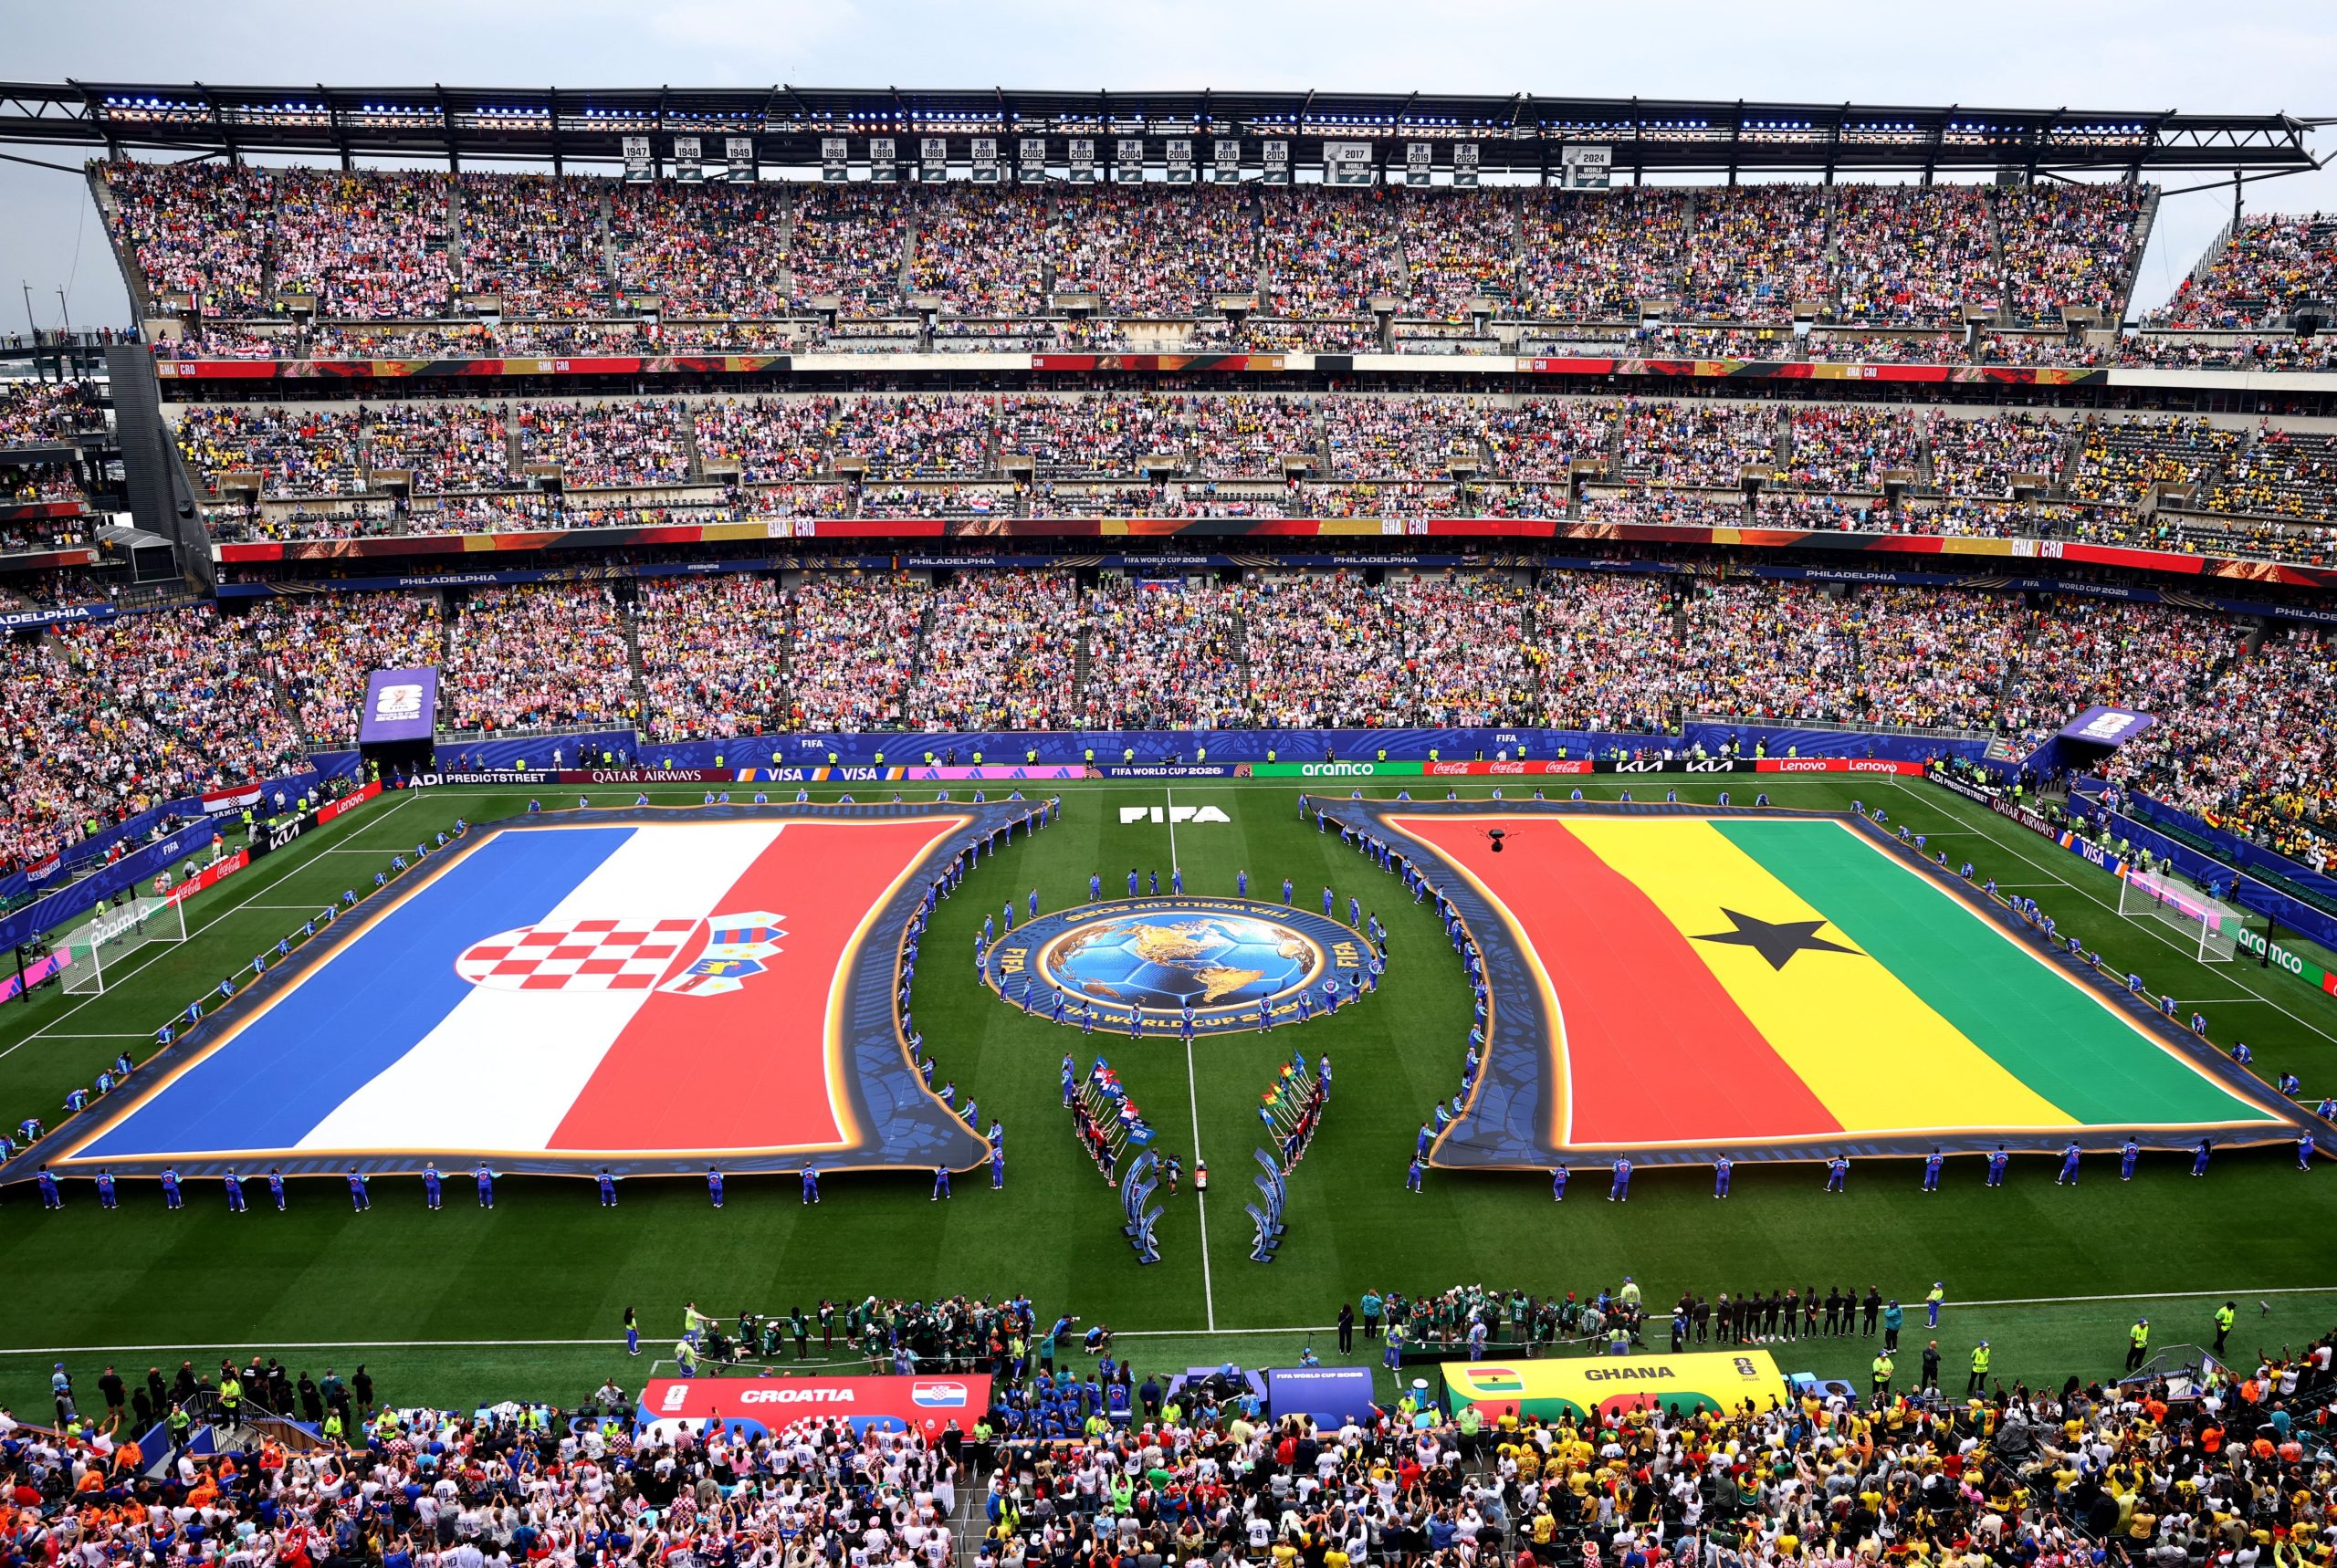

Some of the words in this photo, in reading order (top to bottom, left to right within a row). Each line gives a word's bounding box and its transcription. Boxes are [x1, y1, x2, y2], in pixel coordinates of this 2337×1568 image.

[626, 148, 646, 157] 1947
[677, 148, 698, 157] 1948
[730, 149, 749, 157] 1949
[825, 149, 844, 157] 1960
[874, 149, 893, 157] 1980
[924, 149, 944, 157] 1988
[975, 149, 993, 157] 2001
[1022, 150, 1043, 158] 2002
[1072, 150, 1092, 158] 2003
[1120, 150, 1140, 159] 2004
[1168, 151, 1189, 159] 2006
[1218, 151, 1236, 159] 2010
[1346, 151, 1364, 159] 2017
[1410, 153, 1428, 162] 2019
[1456, 154, 1476, 162] 2022
[1584, 154, 1604, 162] 2024
[539, 361, 551, 371] GHA
[556, 361, 569, 371] CRO
[1033, 358, 1043, 366] CRO
[1518, 360, 1531, 370] GHA
[1535, 360, 1546, 370] CRO
[160, 365, 175, 375] GHA
[180, 365, 195, 375] CRO
[1847, 367, 1860, 377] GHA
[1864, 367, 1877, 377] CRO
[767, 522, 787, 537] GHA
[796, 521, 815, 537] CRO
[1382, 520, 1401, 535] GHA
[1410, 520, 1428, 535] CRO
[2011, 540, 2035, 557] GHA
[2041, 541, 2064, 559] CRO
[400, 574, 497, 585] PHILADELPHIA
[1807, 570, 1896, 580] PHILADELPHIA
[2059, 582, 2084, 591] WORLD
[2086, 584, 2101, 592] CUP
[2101, 587, 2129, 596] 2026
[1302, 763, 1373, 776] aramco
[1433, 762, 1470, 774] Coca-Cola
[1490, 762, 1526, 774] Coca-Cola
[1546, 761, 1582, 773] Coca-Cola
[1780, 760, 1826, 771] Lenovo
[1849, 760, 1897, 772] Lenovo
[592, 771, 638, 783] QATAR
[645, 770, 701, 781] AIRWAYS
[765, 768, 803, 781] VISA
[839, 768, 877, 780] VISA
[409, 774, 444, 788] ADI
[446, 773, 546, 783] PREDICTSTREET
[1929, 771, 1943, 784] ADI
[1944, 779, 1987, 803] PREDICTSTREET
[337, 792, 364, 814] Lenovo
[1119, 806, 1231, 823] FIFA
[1994, 800, 2018, 821] QATAR
[2021, 815, 2054, 838] AIRWAYS
[163, 841, 179, 855] FIFA
[2081, 841, 2103, 867] VISA
[217, 853, 240, 880] Coca-Cola
[176, 874, 201, 899] Coca-Cola
[1176, 902, 1244, 911] WORLD
[1066, 905, 1130, 922] 2026
[1251, 907, 1290, 919] FIFA
[91, 905, 149, 946] aramo
[1332, 941, 1359, 967] FIFA
[2238, 927, 2302, 974] aramco
[1001, 947, 1028, 974] FIFA
[1192, 1017, 1236, 1026] CUP
[1132, 1129, 1148, 1140] FIFA
[1585, 1366, 1675, 1381] GHANA
[740, 1389, 854, 1404] CROATIA
[1987, 1416, 1993, 1425] 7
[1180, 1437, 1186, 1446] 3
[1385, 1446, 1393, 1455] 14
[439, 1488, 447, 1498] 10
[2183, 1487, 2193, 1497] 12
[931, 1548, 938, 1557] 9
